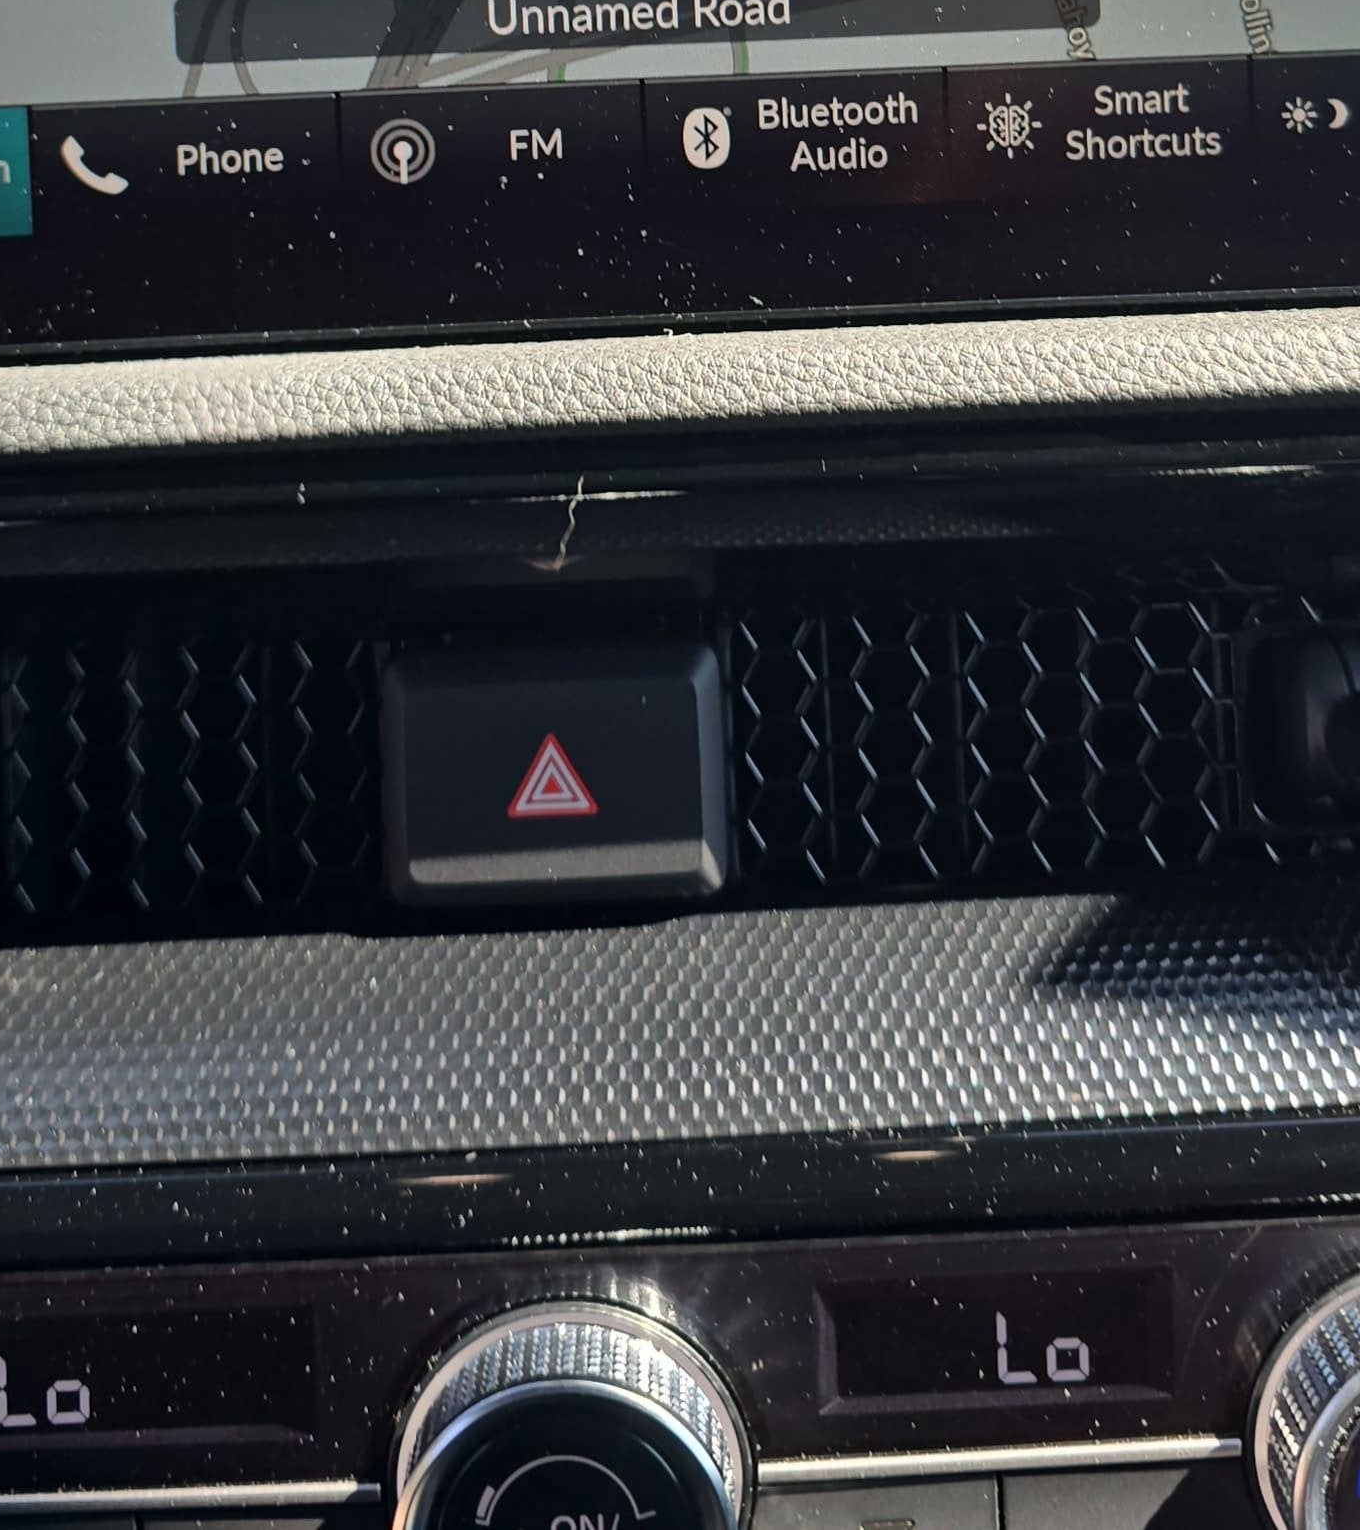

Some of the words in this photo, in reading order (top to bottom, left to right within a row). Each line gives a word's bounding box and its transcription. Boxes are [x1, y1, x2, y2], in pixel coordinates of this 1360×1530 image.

[757, 91, 918, 130] Bluetooth
[1094, 82, 1190, 116] Smart
[176, 141, 284, 176] Phone
[510, 127, 563, 161] FM
[790, 137, 888, 172] Audio
[1066, 126, 1222, 161] Shortcuts
[995, 1311, 1090, 1385] Lo
